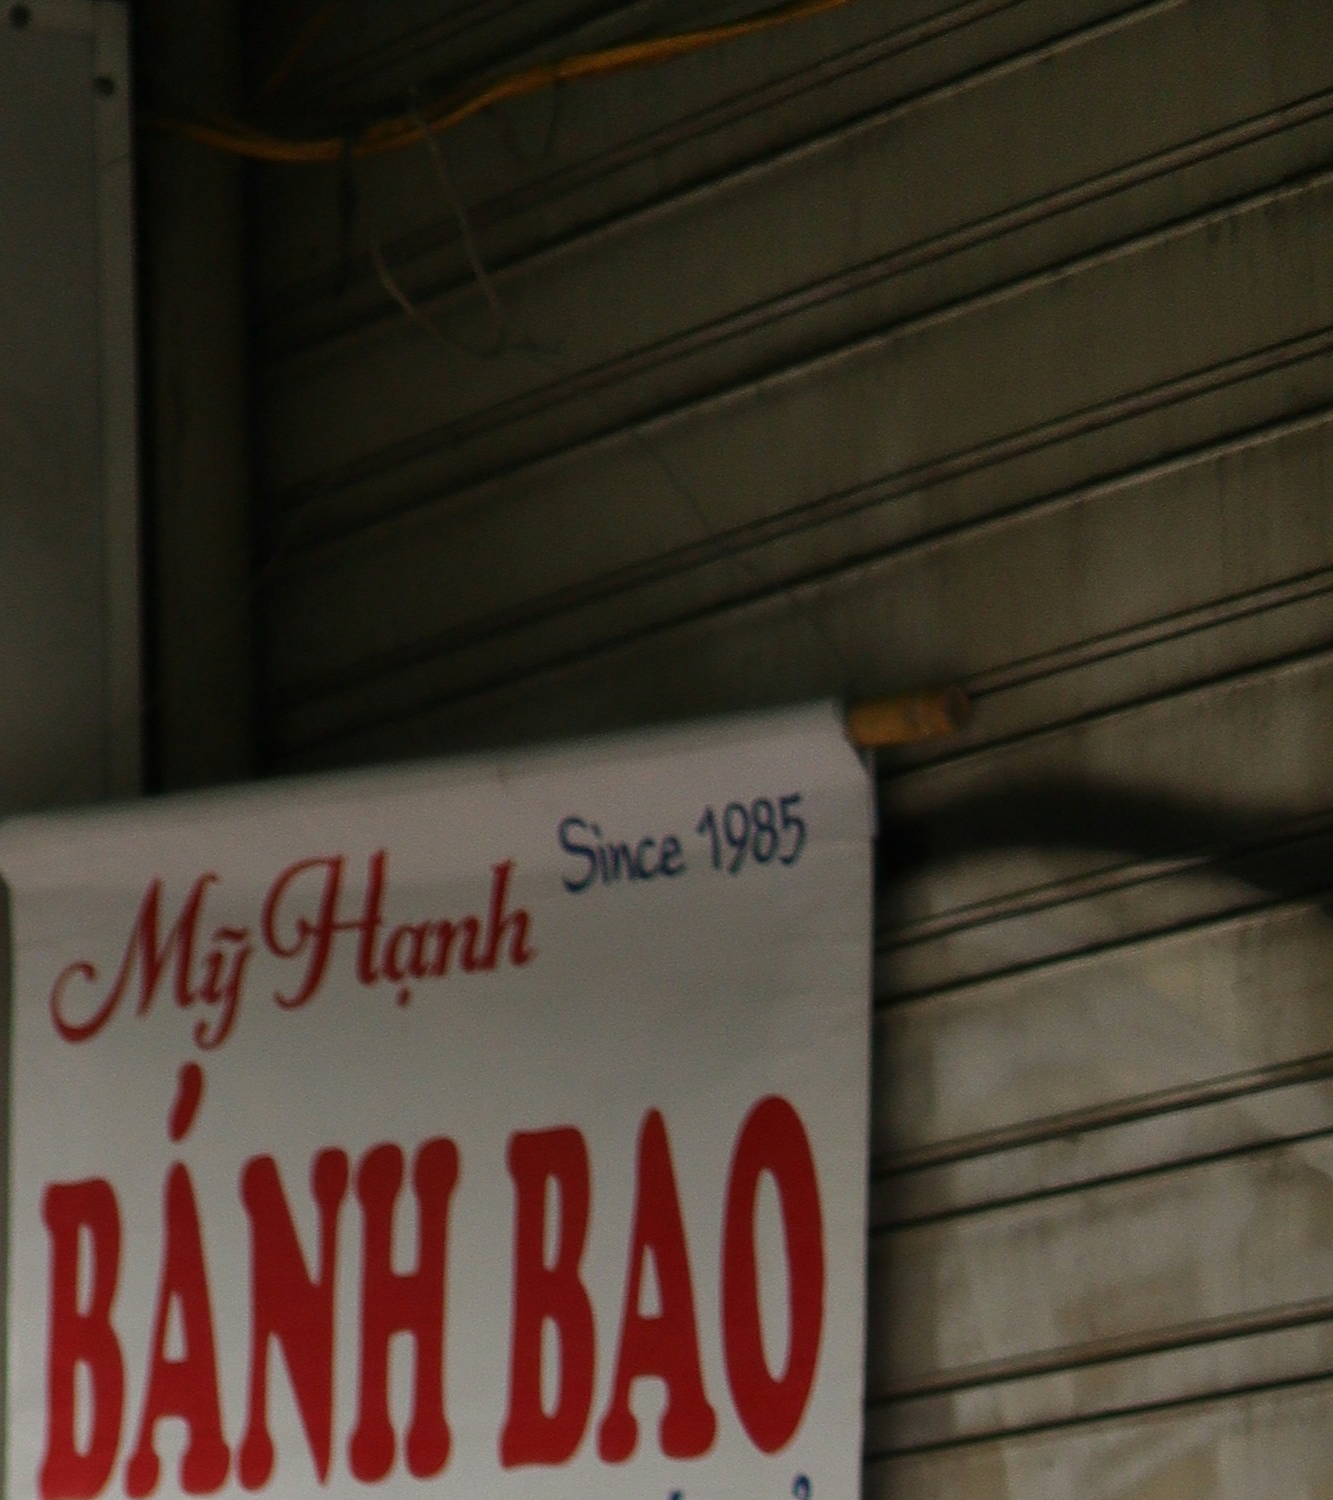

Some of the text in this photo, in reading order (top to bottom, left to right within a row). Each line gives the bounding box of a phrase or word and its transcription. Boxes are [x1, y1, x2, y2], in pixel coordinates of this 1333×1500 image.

[557, 794, 807, 892] Since 1985
[49, 849, 538, 1050] Mỹ Hạnh
[500, 1094, 825, 1469] BAO
